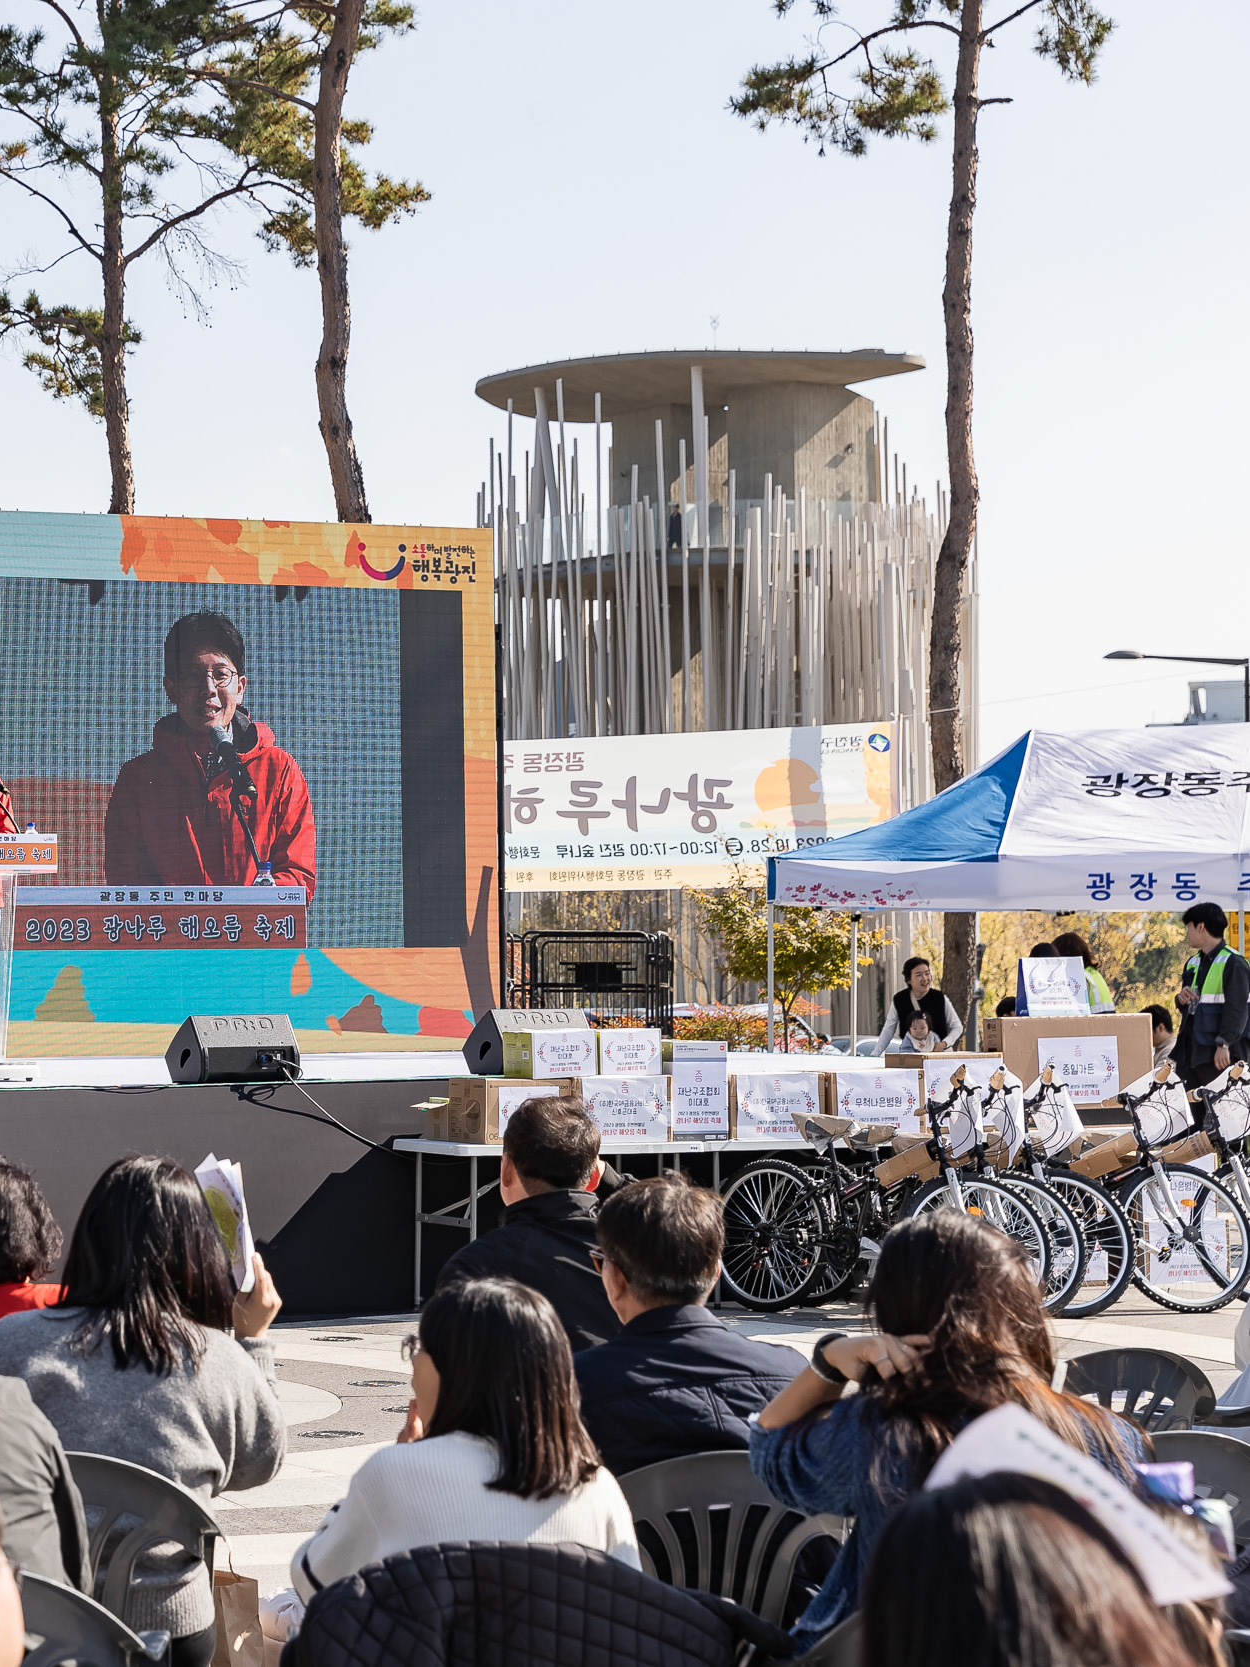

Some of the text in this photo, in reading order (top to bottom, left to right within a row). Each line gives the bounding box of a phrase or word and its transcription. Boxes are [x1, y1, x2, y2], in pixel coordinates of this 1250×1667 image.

[443, 545, 475, 559] 발전하는
[411, 557, 476, 584] 행복광진
[31, 847, 52, 861] 축제
[1086, 872, 1201, 901] 광장동
[100, 891, 224, 902] 광장동 주민 한마당
[25, 914, 295, 942] 2023 광나루 해오름 축제
[1062, 1063, 1095, 1075] 중일가든
[695, 1070, 702, 1083] 증
[621, 1081, 629, 1094] 증
[677, 1086, 721, 1096] 재난구조협회
[688, 1097, 710, 1107] 이대호
[855, 1096, 902, 1108] 무척나은병원
